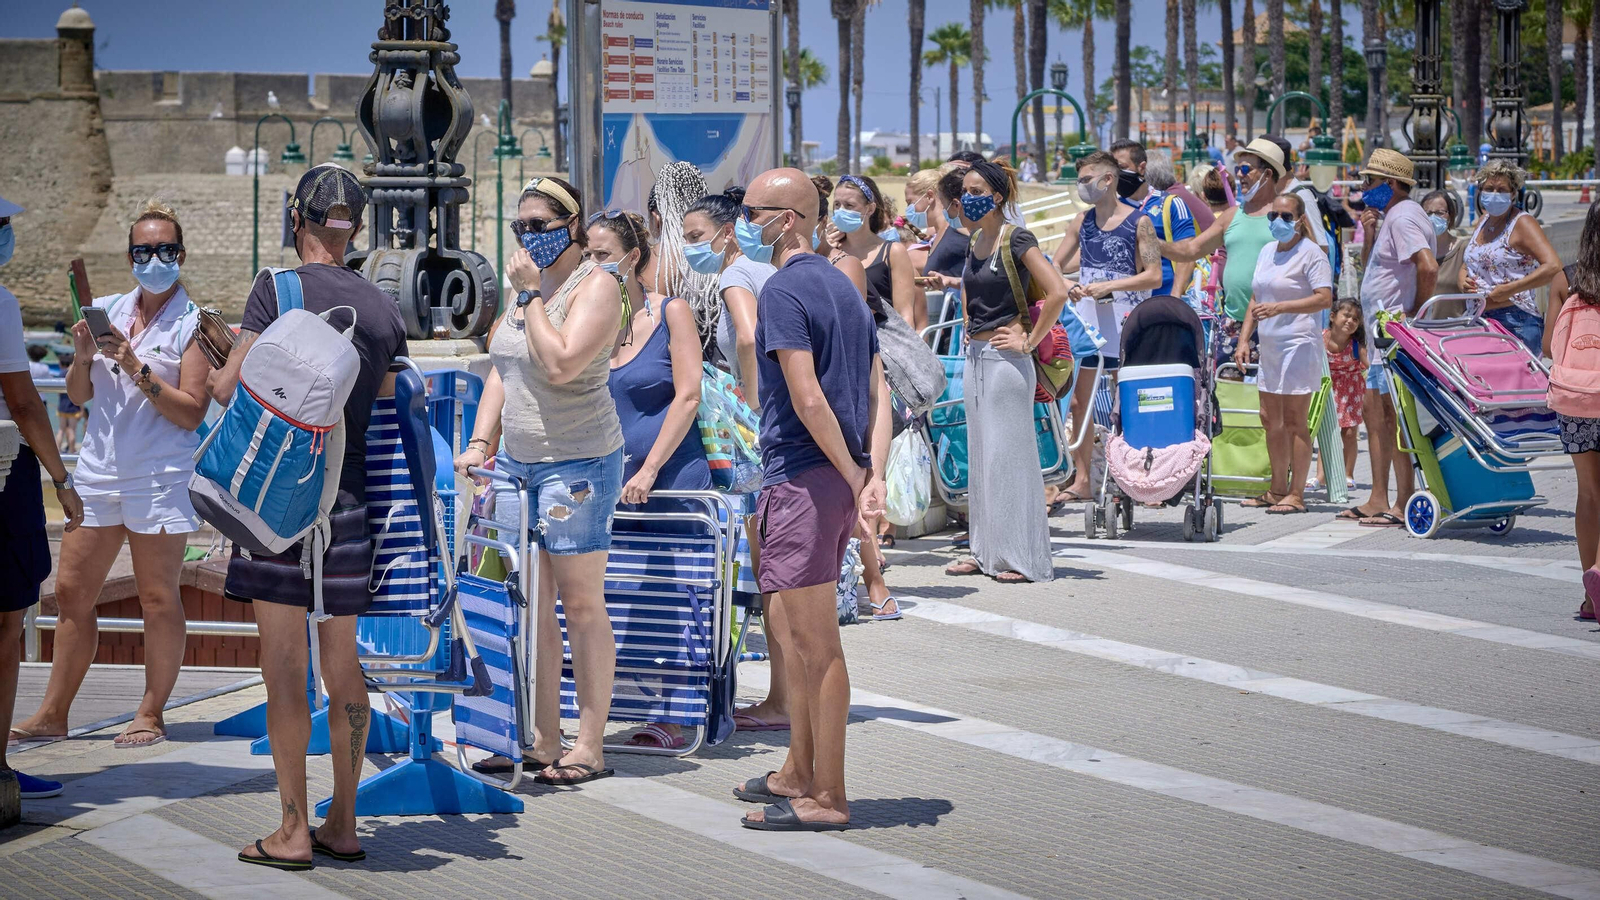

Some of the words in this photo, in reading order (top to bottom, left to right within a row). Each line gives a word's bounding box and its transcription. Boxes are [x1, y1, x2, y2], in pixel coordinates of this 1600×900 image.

[603, 10, 619, 18] Normas
[620, 11, 624, 19] de
[626, 11, 644, 20] conducta
[669, 58, 684, 66] Servicios
